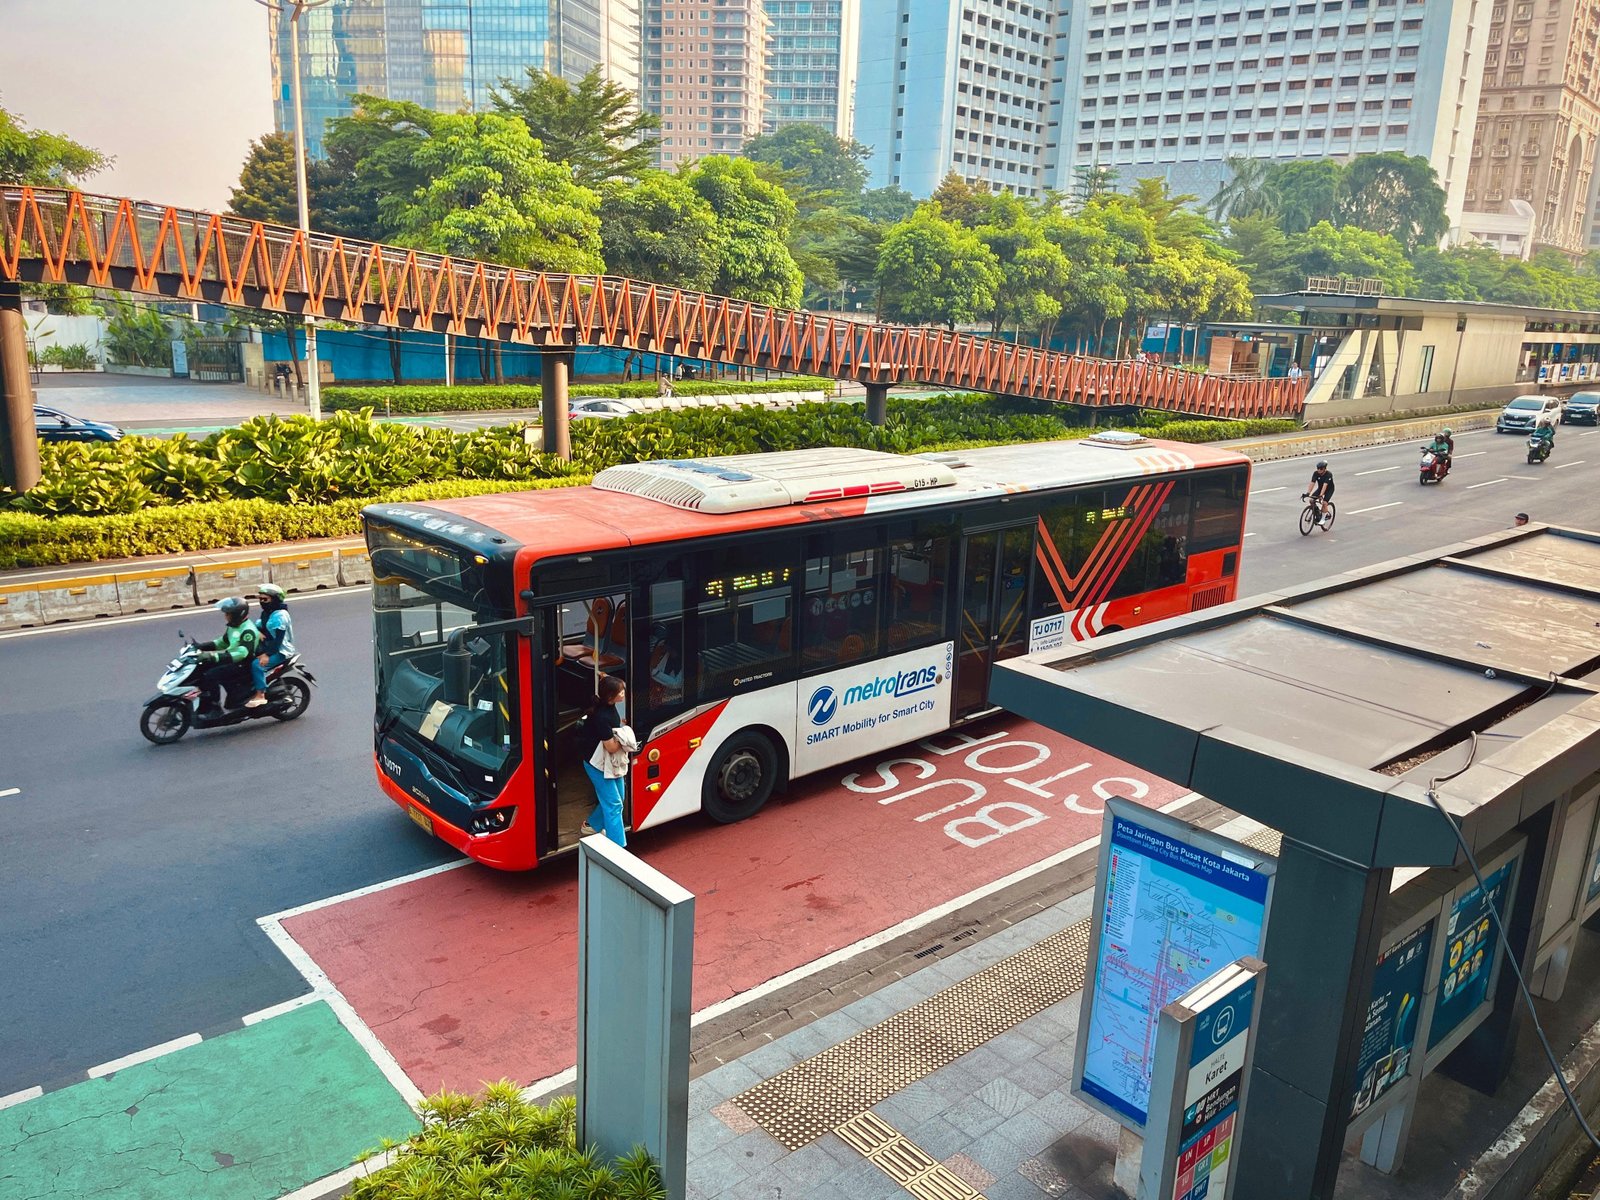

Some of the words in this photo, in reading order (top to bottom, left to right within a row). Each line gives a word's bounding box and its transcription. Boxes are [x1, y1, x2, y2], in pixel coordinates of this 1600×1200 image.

[1034, 625, 1043, 635] TJ
[1044, 621, 1062, 633] 0717
[753, 671, 773, 680] TRACTORS
[843, 665, 936, 705] metrotrans
[806, 726, 841, 746] SMART
[842, 716, 877, 734] Mobility
[878, 713, 891, 723] for
[892, 706, 918, 719] Smart
[919, 700, 935, 711] City
[841, 758, 1051, 848] BUS
[1116, 831, 1142, 845] Downtown
[1141, 840, 1159, 853] Jakarta
[1159, 847, 1169, 858] City
[1169, 851, 1179, 860] Bus
[1179, 855, 1200, 870] Network
[1201, 864, 1213, 875] Map
[1117, 822, 1133, 835] Peta
[1134, 828, 1165, 848] Jaringan
[1165, 841, 1179, 853] Bus
[1180, 847, 1201, 862] Pusat
[1202, 857, 1221, 870] Kota
[1221, 864, 1250, 882] Jakarta
[1205, 1061, 1228, 1085] Karet
[1206, 1087, 1220, 1103] MRT
